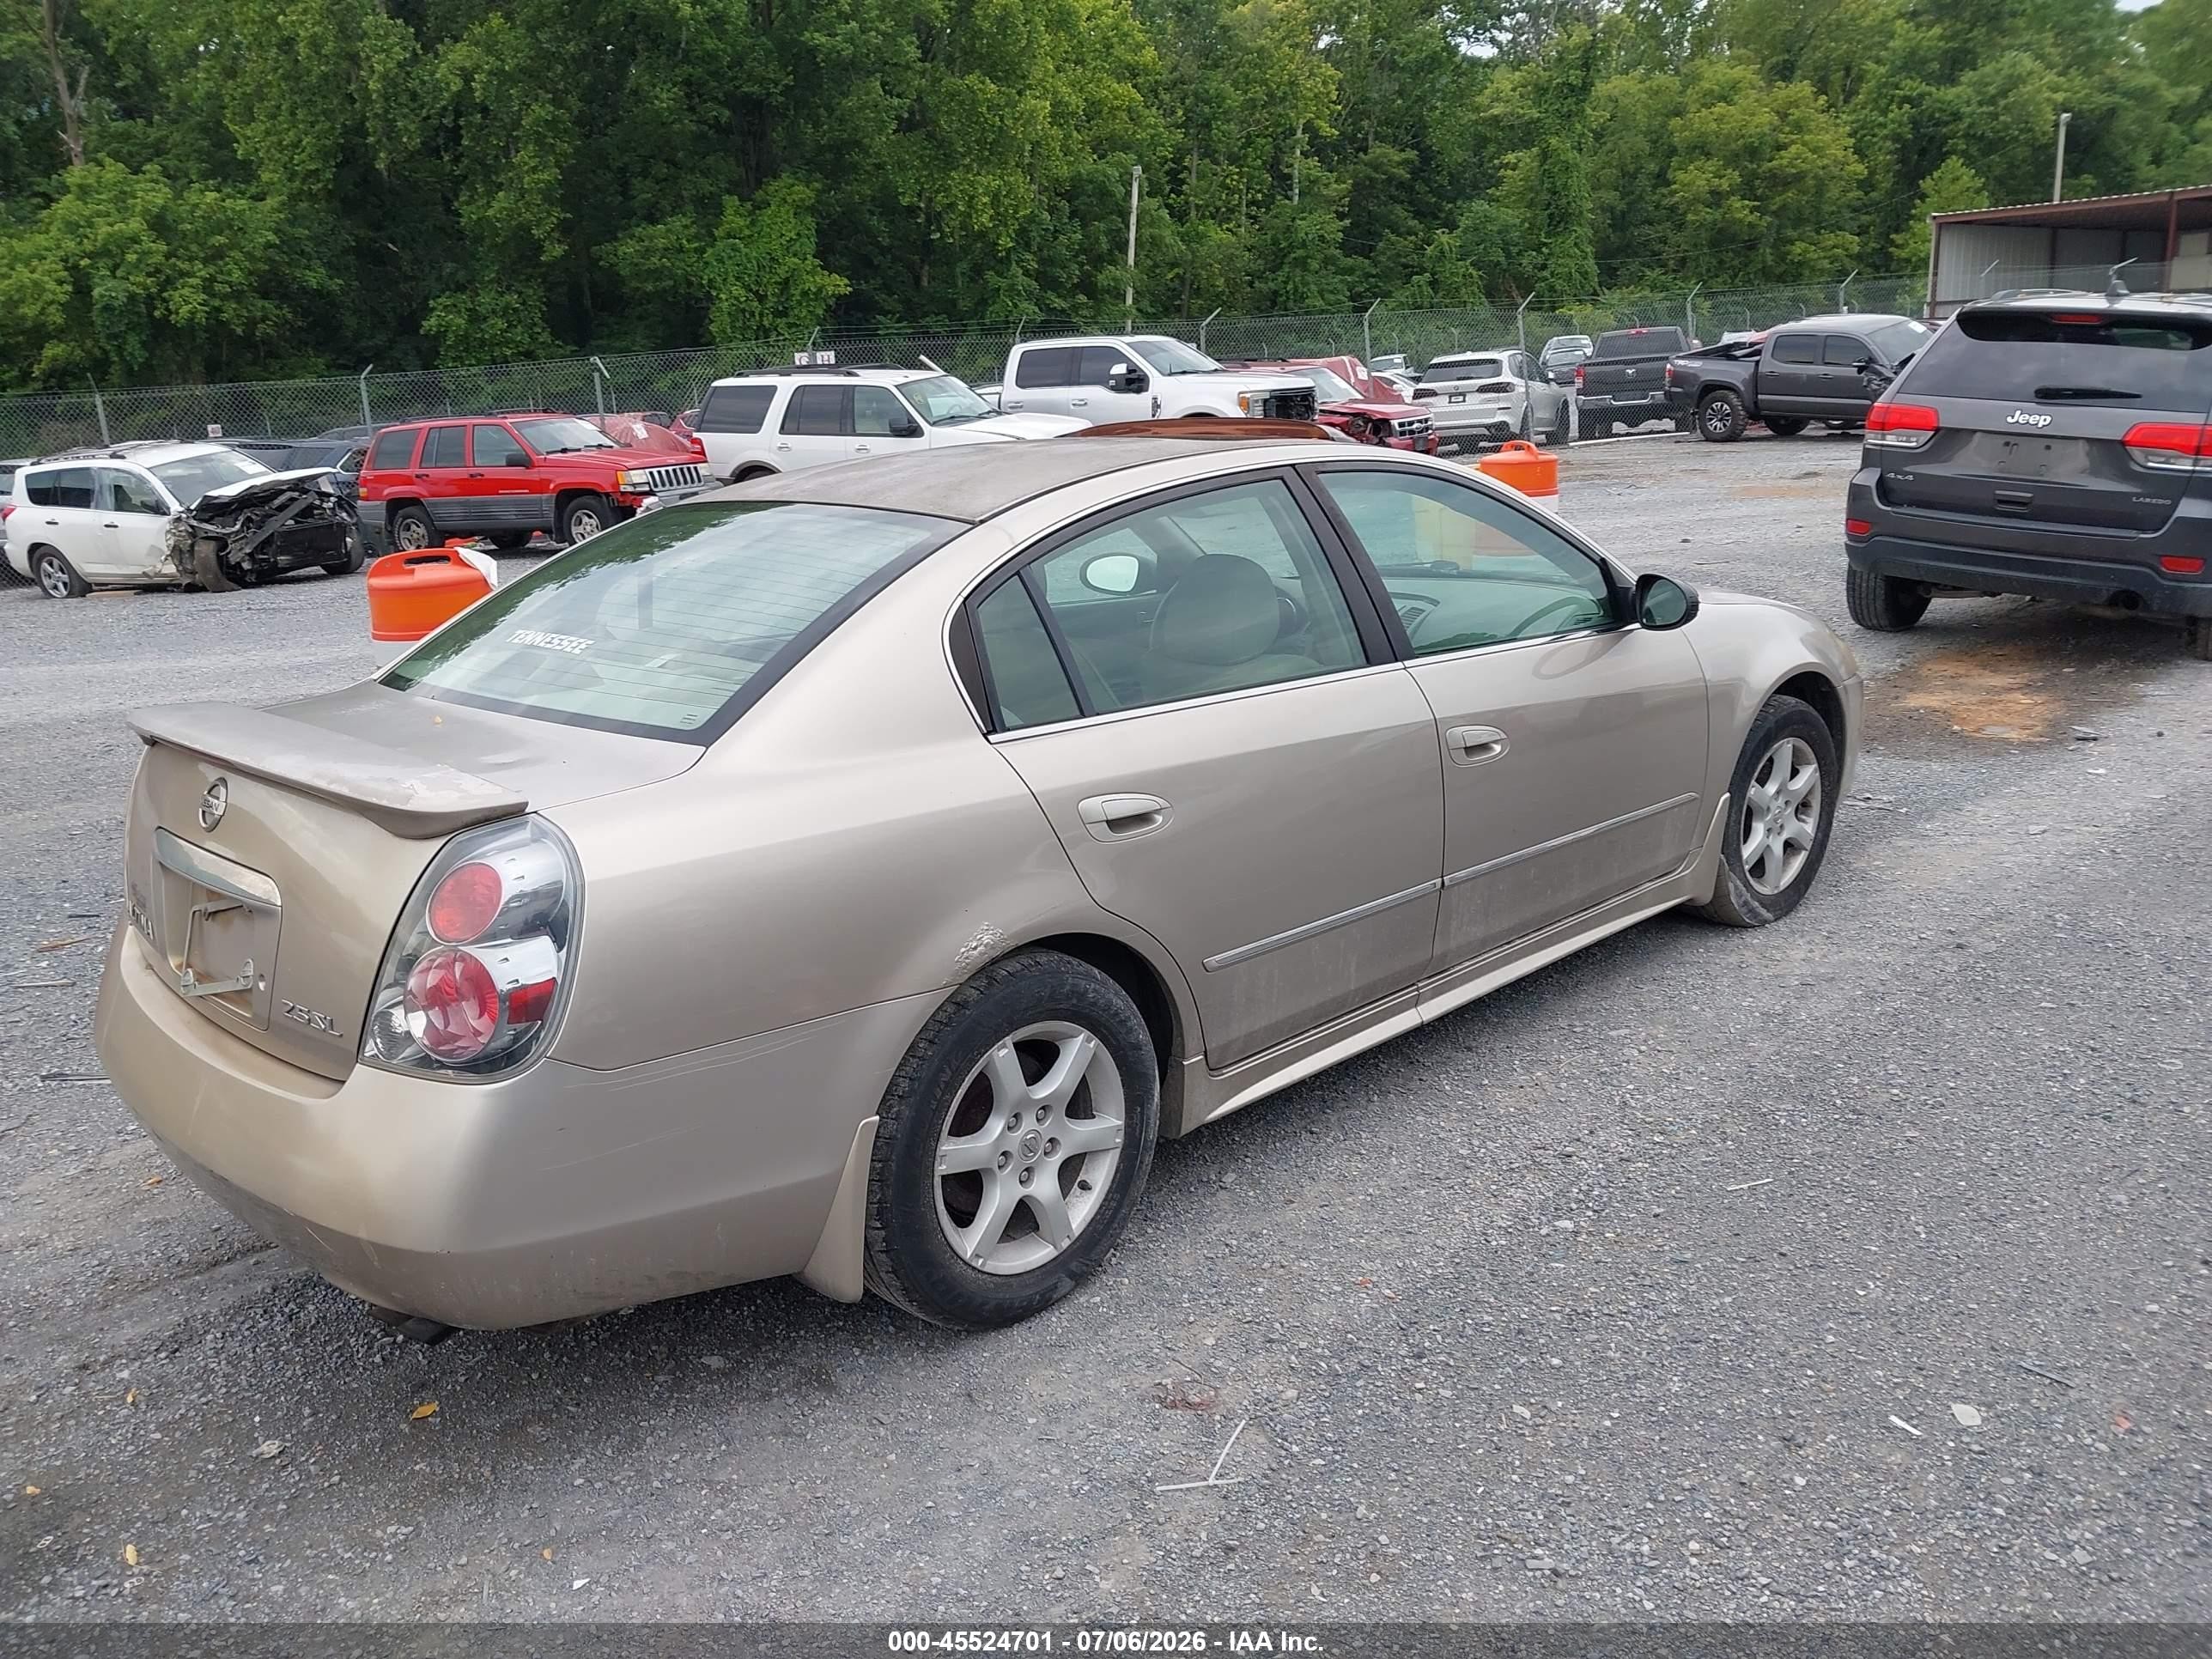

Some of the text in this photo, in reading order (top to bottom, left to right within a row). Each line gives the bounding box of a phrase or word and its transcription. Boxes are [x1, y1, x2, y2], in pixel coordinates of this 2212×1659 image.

[2006, 410, 2053, 428] Jeep
[2131, 496, 2172, 505] LAREDO
[506, 629, 596, 654] TENNESSEE
